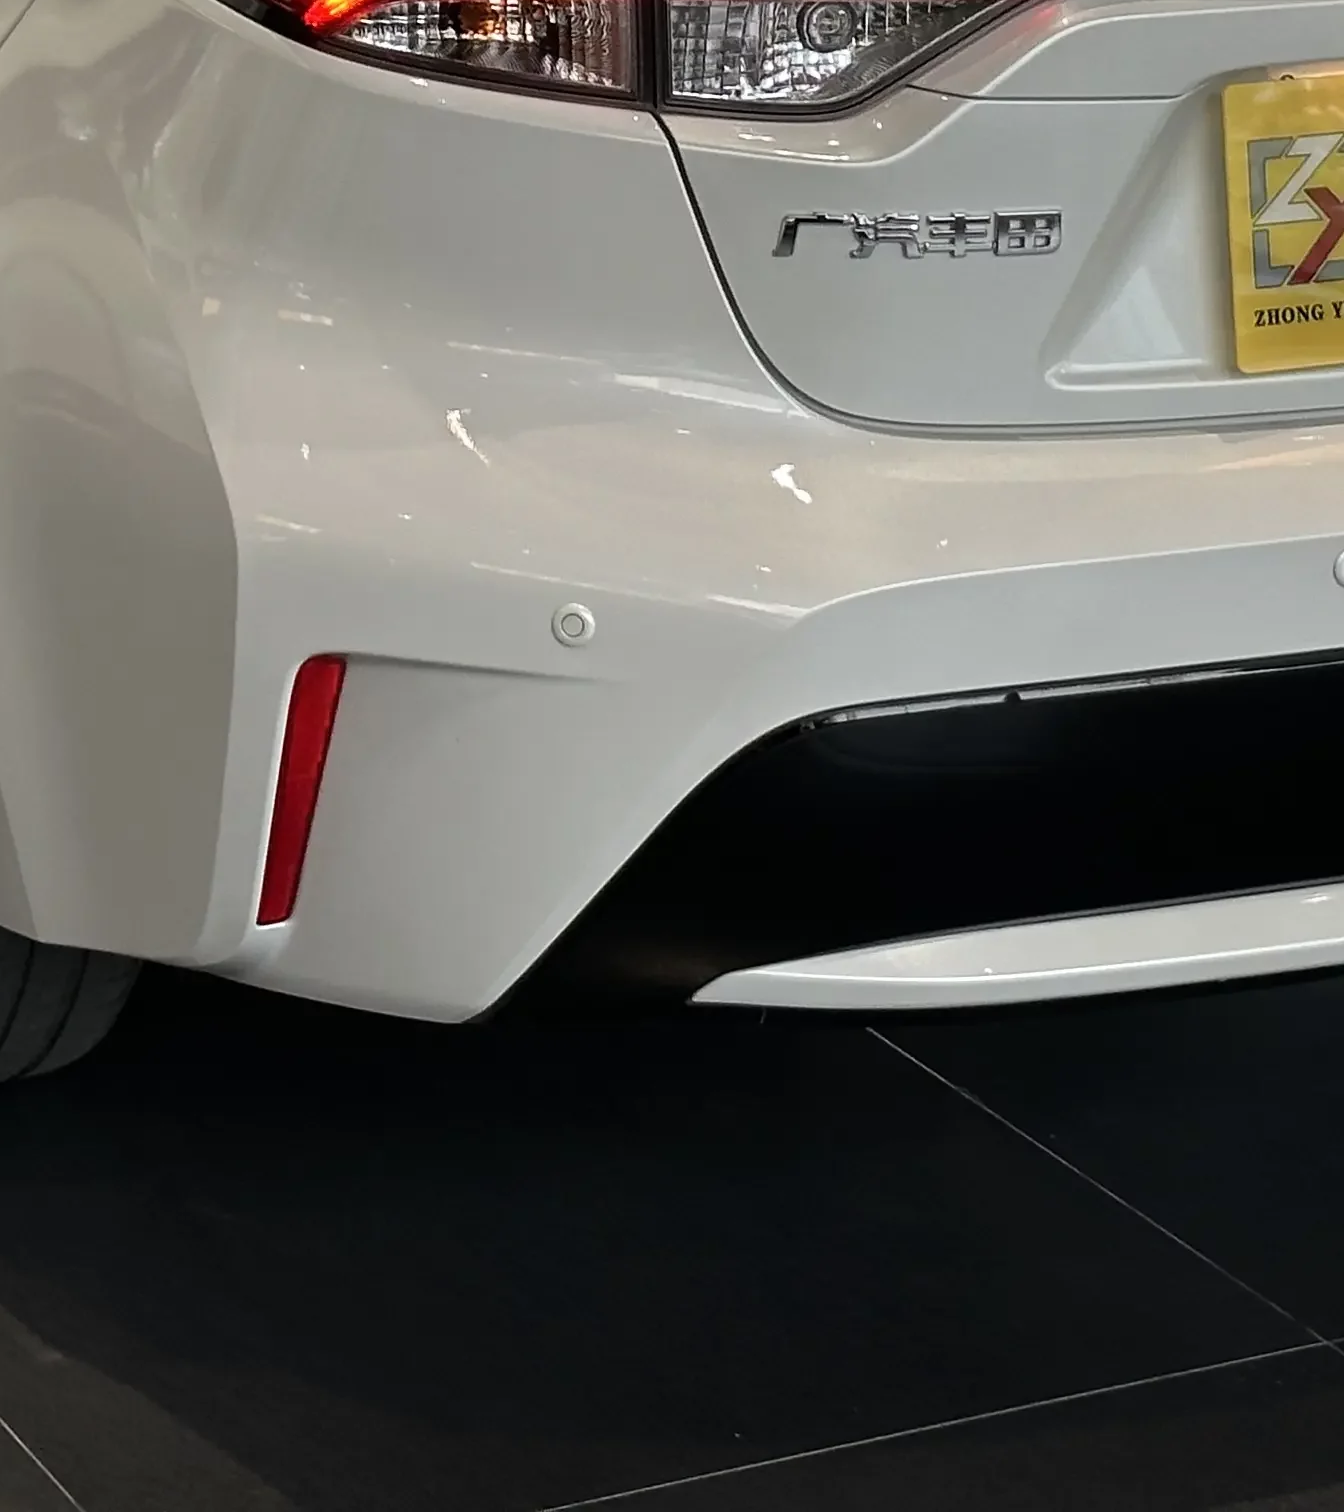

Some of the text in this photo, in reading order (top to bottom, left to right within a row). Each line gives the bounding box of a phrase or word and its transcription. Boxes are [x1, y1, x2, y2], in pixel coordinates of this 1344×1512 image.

[771, 208, 1063, 259] 广汽丰田
[1254, 303, 1326, 328] ZHONG
